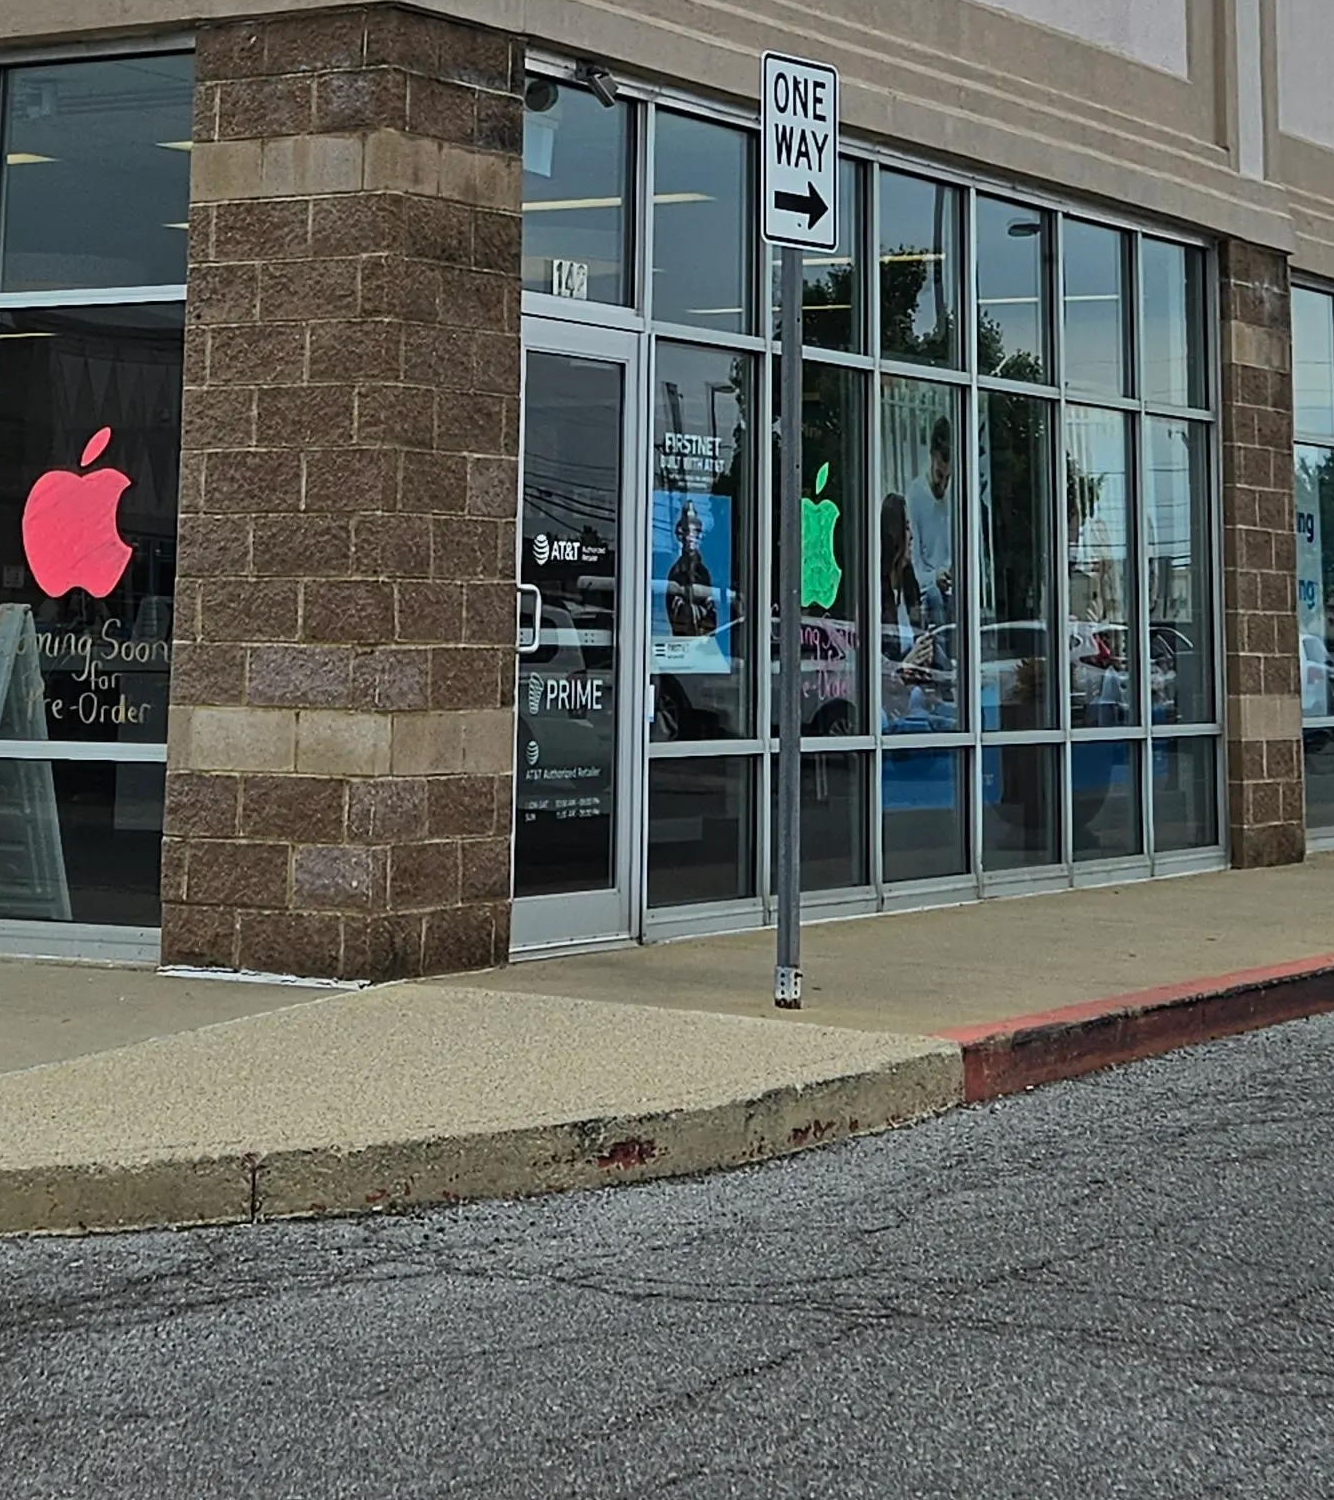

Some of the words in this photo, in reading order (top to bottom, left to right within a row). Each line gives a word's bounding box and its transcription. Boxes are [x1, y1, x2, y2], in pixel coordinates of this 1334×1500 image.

[774, 72, 827, 122] ONE
[774, 123, 829, 173] WAY
[665, 432, 722, 457] FIRSTNET
[551, 541, 580, 561] AT&T
[101, 618, 169, 663] Soon
[89, 660, 122, 690] for
[546, 679, 603, 710] PRIME
